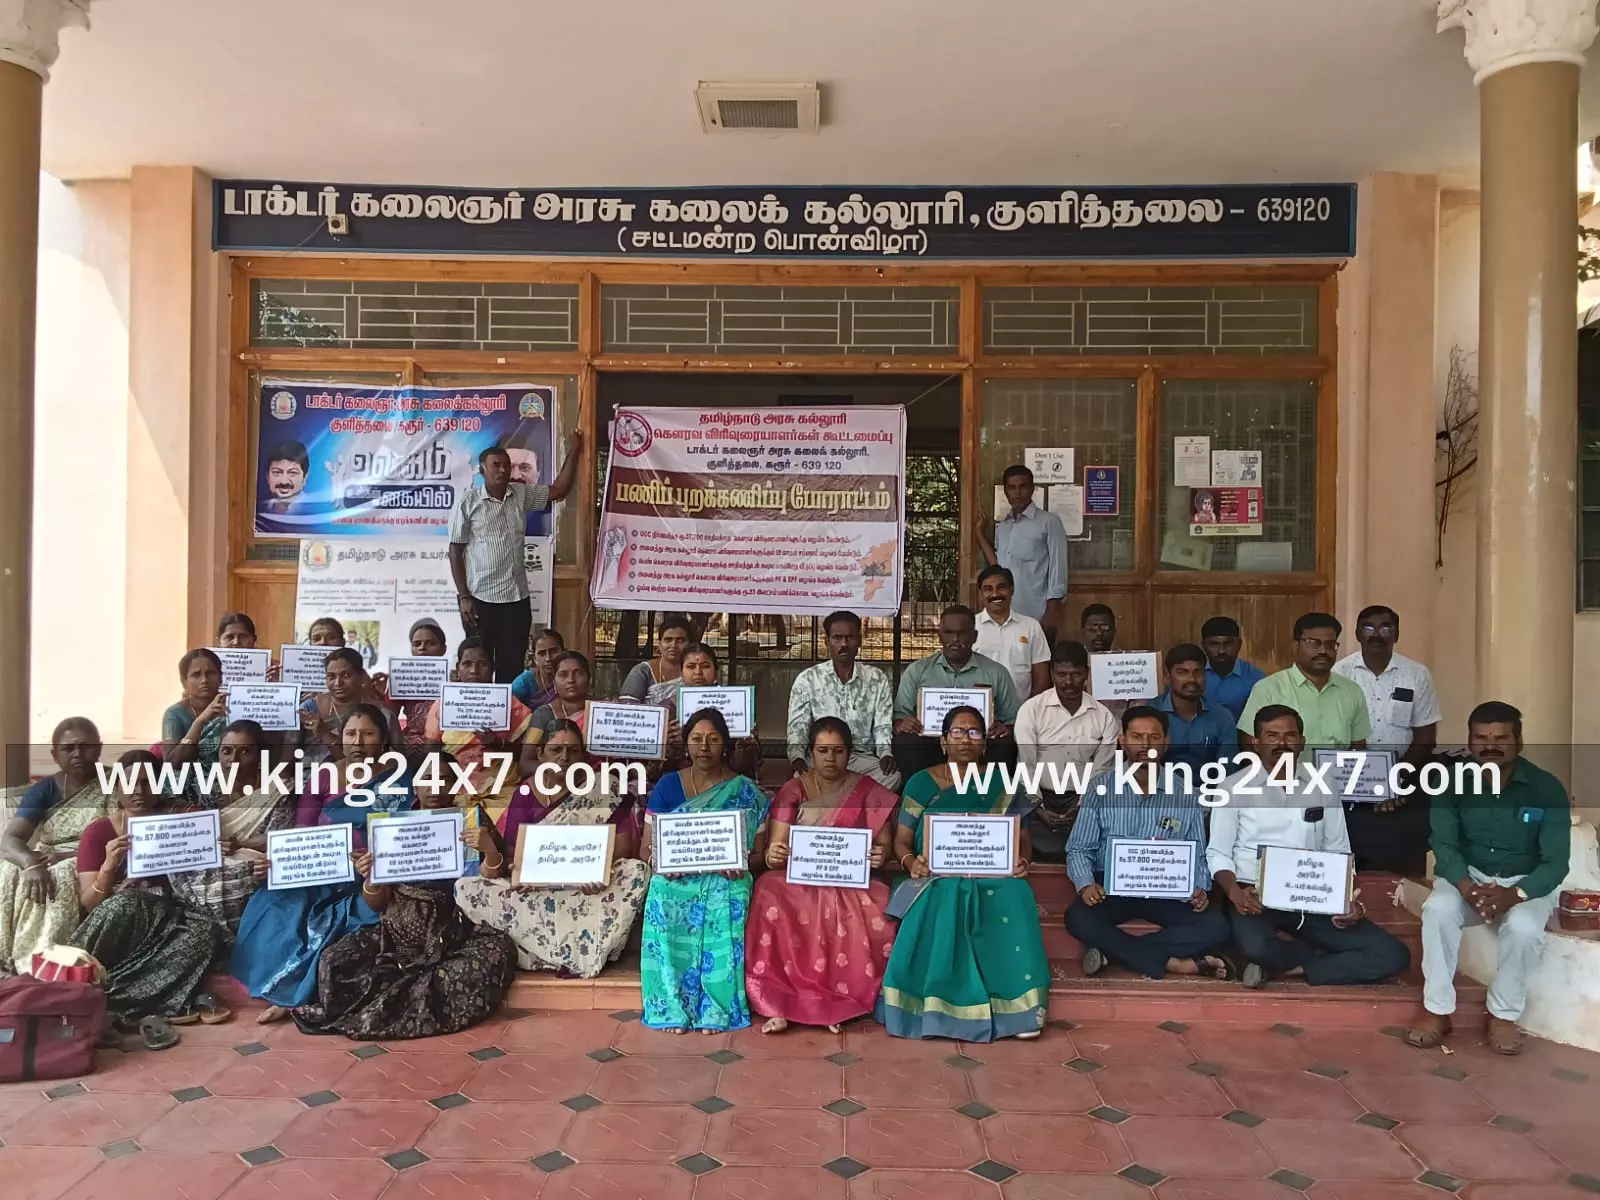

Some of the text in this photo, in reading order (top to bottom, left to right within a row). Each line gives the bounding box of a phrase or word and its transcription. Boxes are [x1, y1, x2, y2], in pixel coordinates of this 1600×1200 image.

[223, 185, 338, 217] டாக்டர்
[351, 190, 525, 225] கலைஞர்
[534, 193, 635, 223] அரசு
[650, 194, 789, 224] கலைக்
[987, 190, 1223, 231] குளித்தலை
[1257, 197, 1330, 223] 639120
[765, 225, 928, 255] பொன்விழா)
[306, 392, 343, 409] டாக்டர்
[344, 395, 393, 413] கலைஞர்
[435, 418, 458, 431] 639
[461, 418, 480, 431] 120
[699, 412, 847, 428] தமிழ்நாடு அரசு கல்லூரி
[654, 428, 893, 444] கௌரவ விரிவுரையாளர்கள் கூட்டமைப்பு
[687, 445, 718, 454] டாக்டர்
[722, 445, 765, 457] கலைஞர்
[768, 447, 791, 457] அரசு
[794, 446, 827, 456] கலைக்
[802, 461, 821, 470] 639
[824, 461, 842, 470] 120
[337, 548, 386, 563] தமிழ்நாடு
[390, 551, 416, 561] அரசு
[539, 842, 567, 852] தமிழக
[537, 854, 566, 864] தமிழக
[1297, 858, 1324, 868] தமிழக
